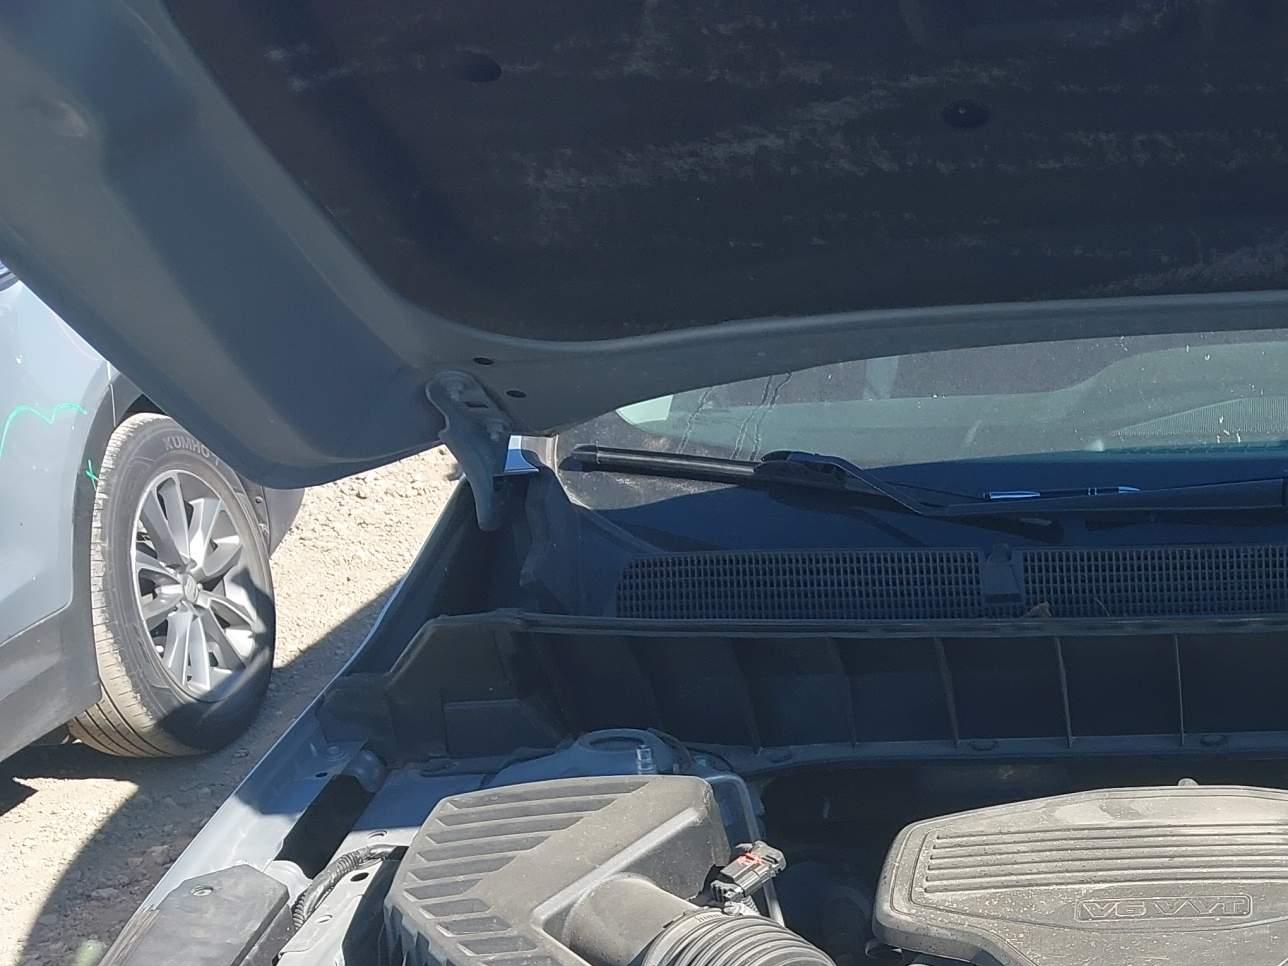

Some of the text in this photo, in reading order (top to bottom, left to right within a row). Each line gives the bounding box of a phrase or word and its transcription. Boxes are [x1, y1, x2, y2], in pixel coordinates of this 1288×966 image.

[162, 435, 210, 458] KUMHO
[1081, 898, 1247, 918] V6 VVT
